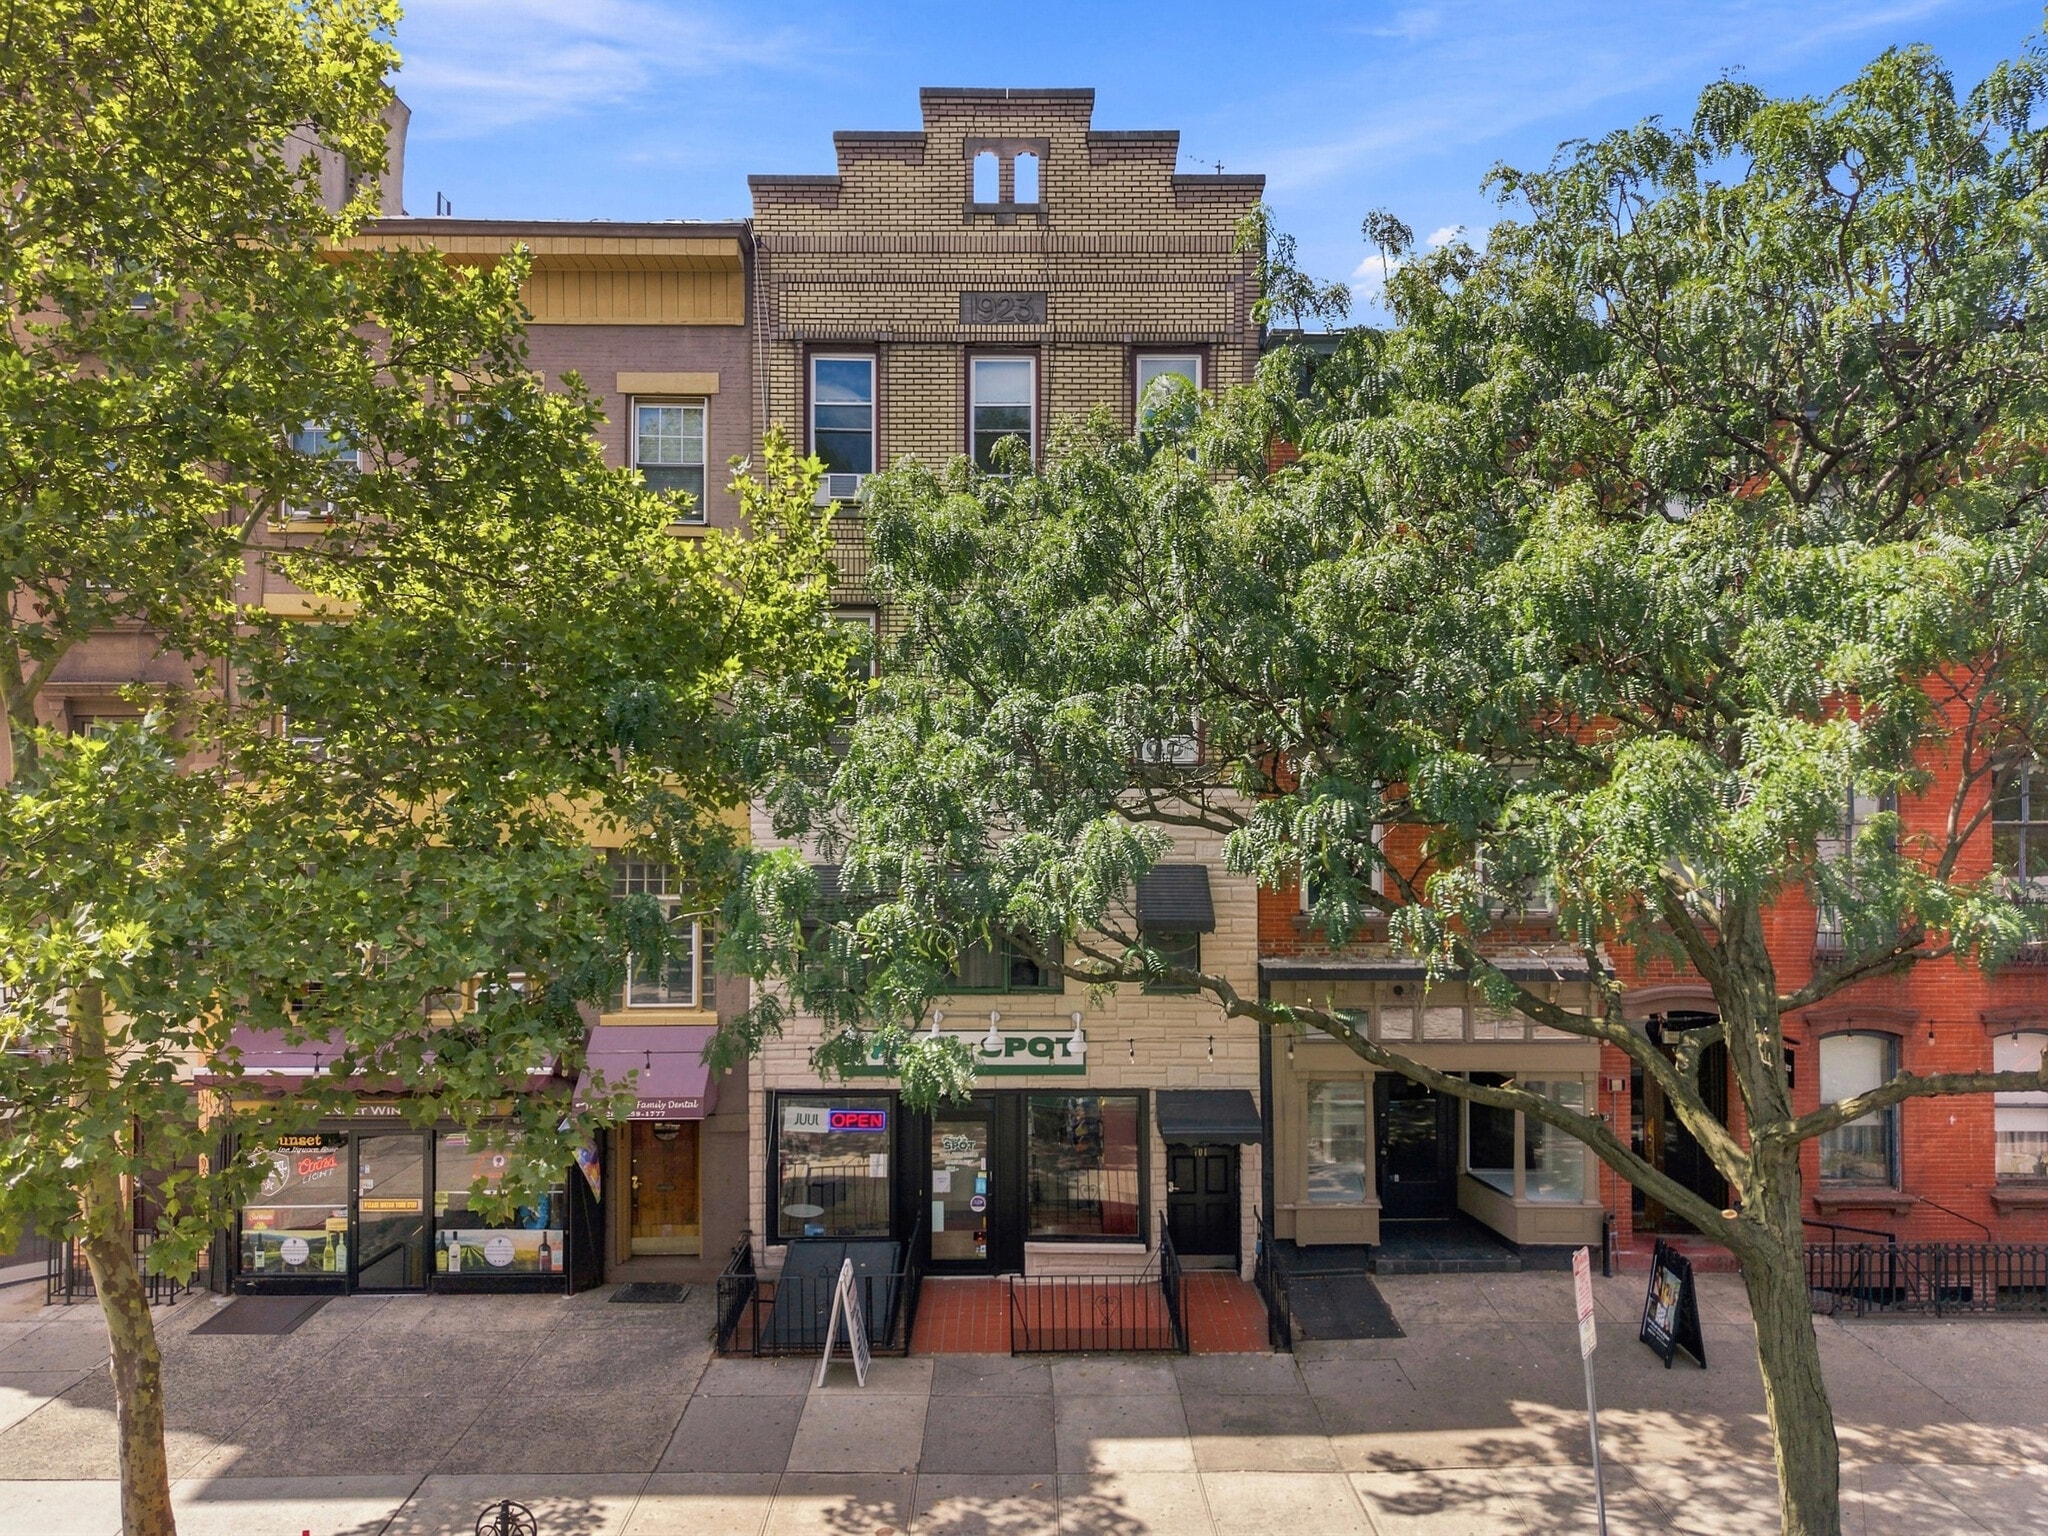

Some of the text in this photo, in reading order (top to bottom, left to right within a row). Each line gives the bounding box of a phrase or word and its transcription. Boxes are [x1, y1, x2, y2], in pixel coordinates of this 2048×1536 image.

[636, 1100, 666, 1110] Family
[667, 1100, 699, 1109] Dental
[794, 1113, 819, 1126] JUUL
[831, 1113, 883, 1127] OPEN
[269, 1133, 322, 1146] unset
[943, 1139, 976, 1151] SPOT
[298, 1155, 338, 1175] Coors
[302, 1168, 335, 1184] LIGHT
